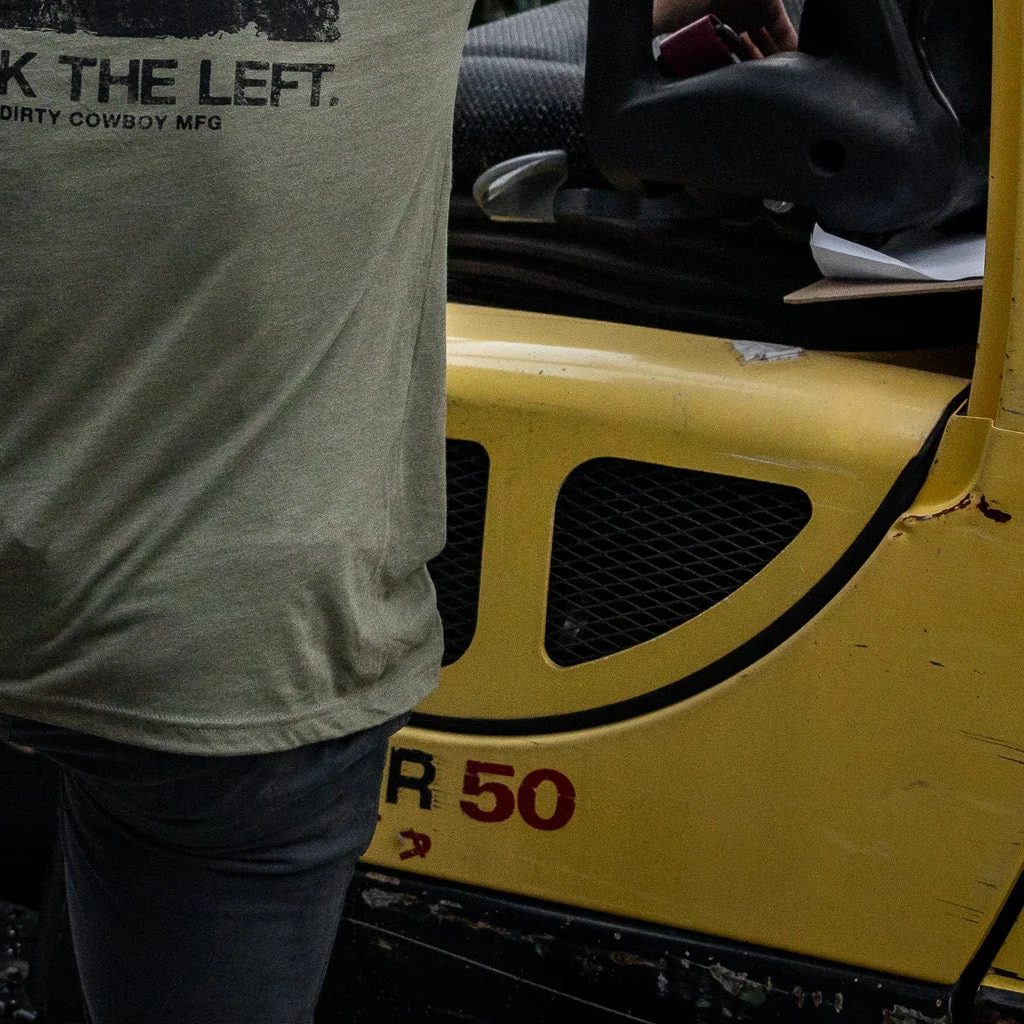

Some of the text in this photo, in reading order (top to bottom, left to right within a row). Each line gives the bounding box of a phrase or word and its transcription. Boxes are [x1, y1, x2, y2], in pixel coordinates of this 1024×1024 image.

[59, 55, 177, 105] THE
[199, 58, 340, 108] LEFT.
[0, 104, 223, 131] DIRTY COWBOY MFG
[459, 759, 577, 832] 50
